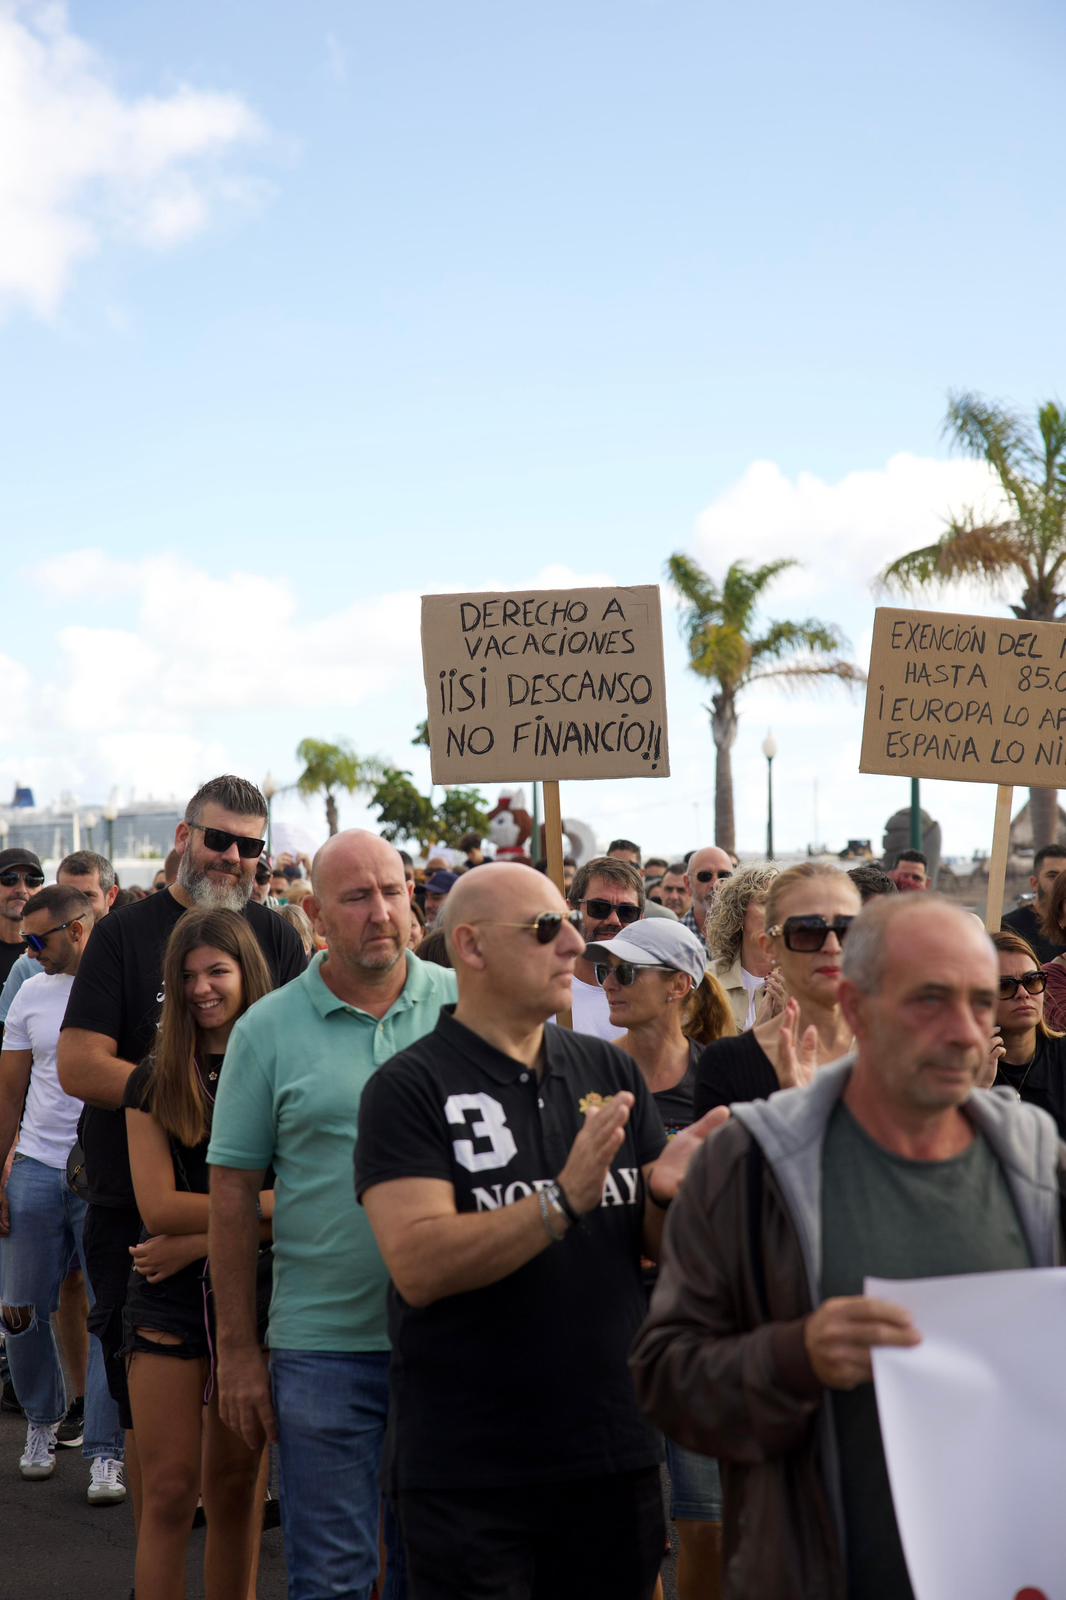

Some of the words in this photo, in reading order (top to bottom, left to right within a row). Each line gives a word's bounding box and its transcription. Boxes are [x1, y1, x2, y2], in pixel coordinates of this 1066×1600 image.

[460, 599, 588, 632] DERECHO
[601, 598, 626, 621] A
[997, 633, 1042, 659] DEL
[507, 670, 652, 707] DESCANSO
[905, 661, 988, 688] HASTA
[1003, 704, 1030, 727] LO
[446, 724, 495, 758] NO
[886, 731, 980, 763] ESPAÑA
[990, 739, 1025, 764] LO
[443, 1092, 518, 1173] 3
[472, 1167, 639, 1209] NOAY
